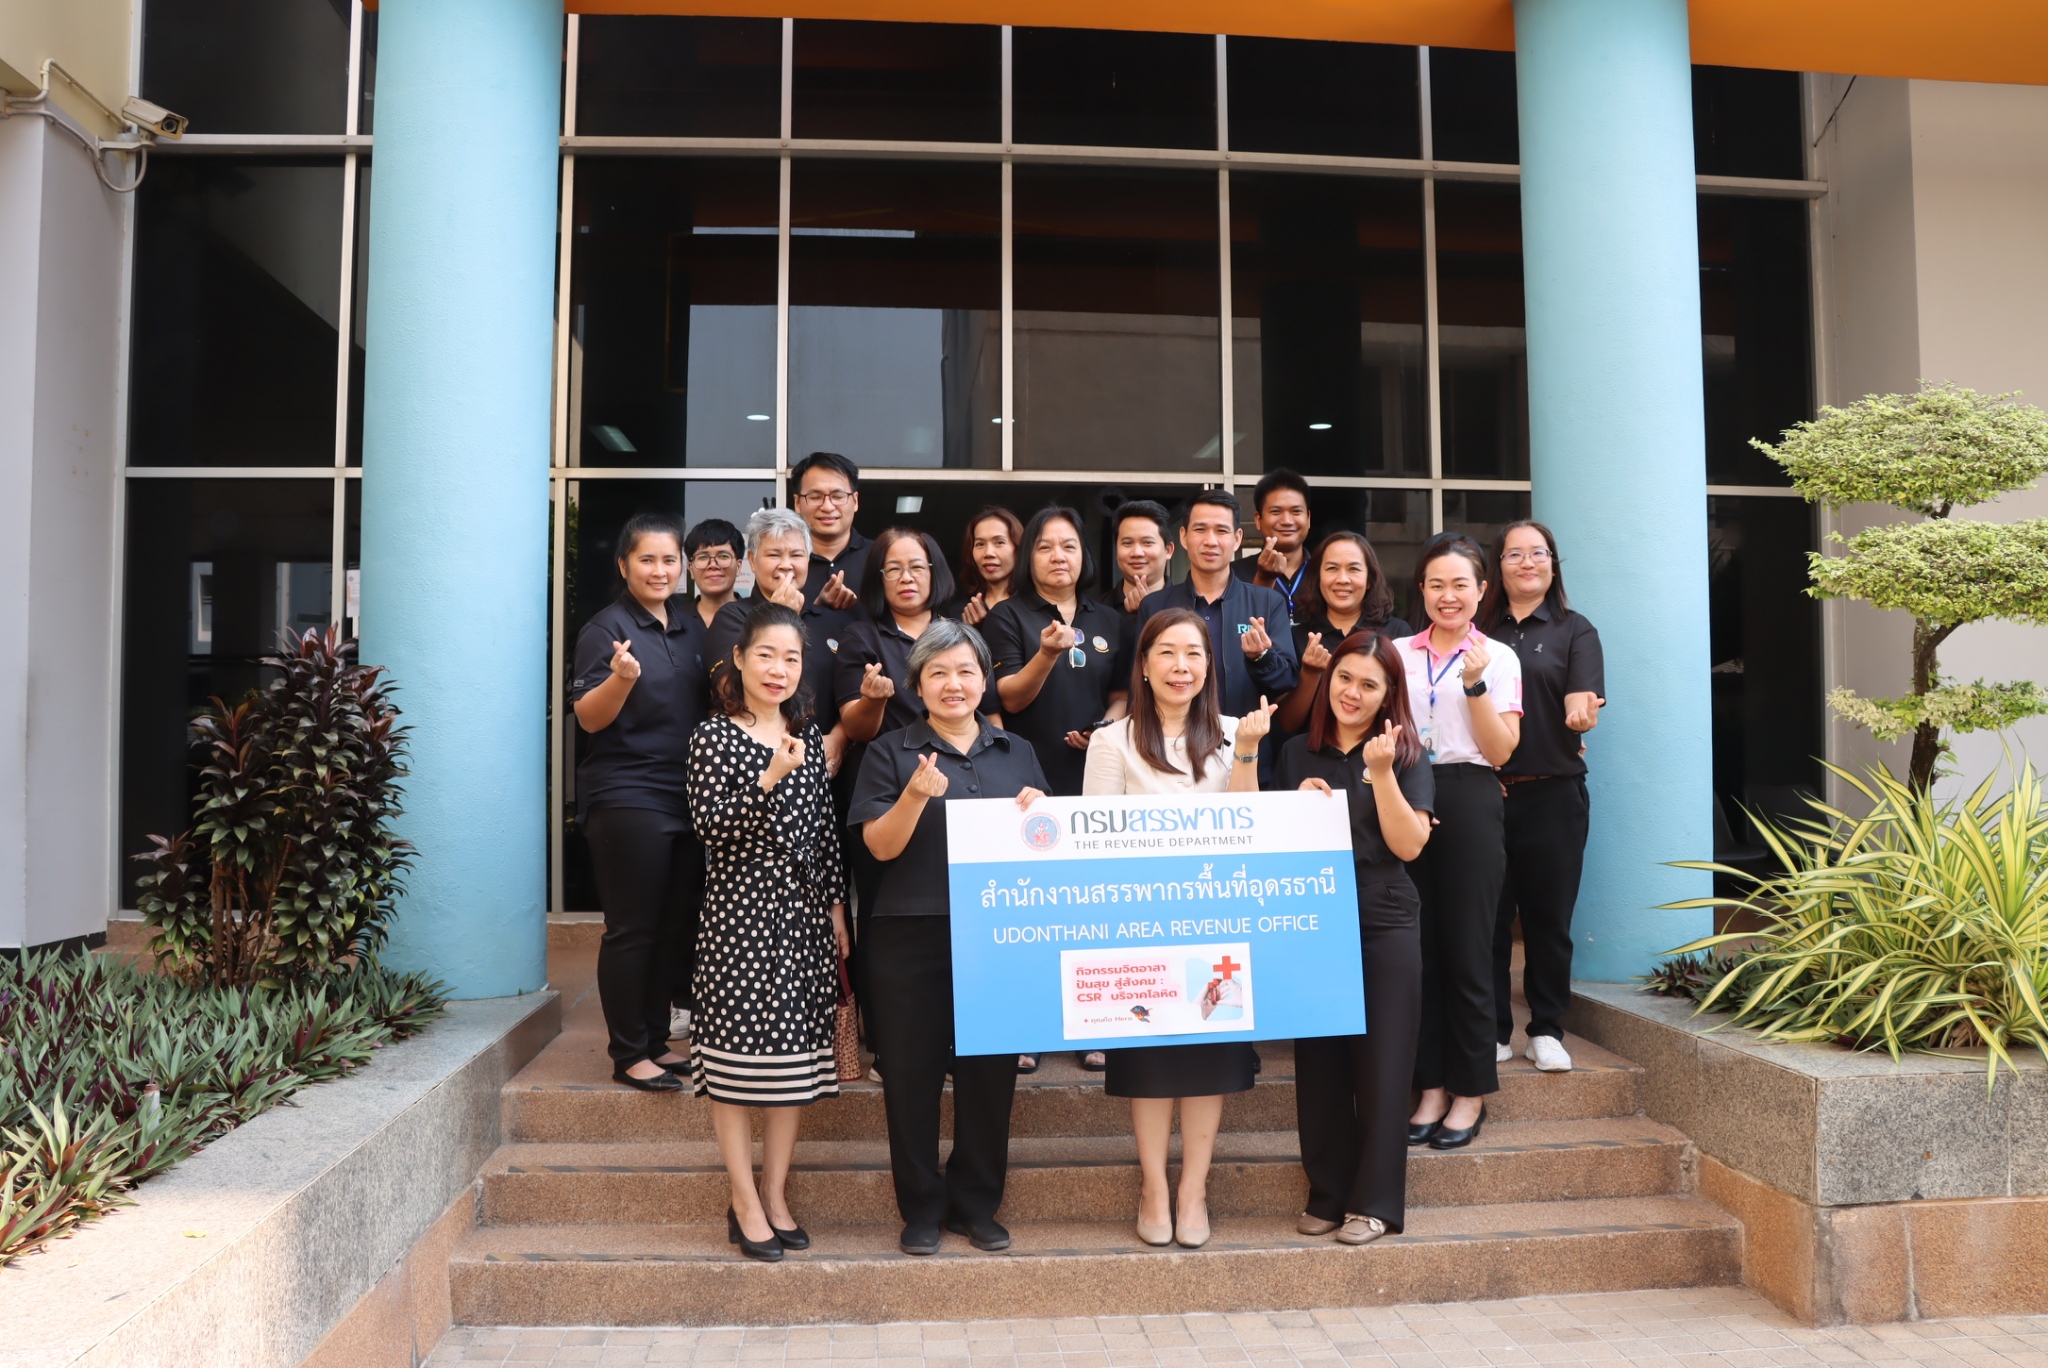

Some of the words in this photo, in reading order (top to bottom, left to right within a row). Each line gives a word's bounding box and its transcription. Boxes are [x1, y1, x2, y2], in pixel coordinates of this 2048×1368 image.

[1070, 806, 1254, 834] กรมสรรพากร
[1074, 840, 1099, 850] THE
[1105, 838, 1164, 849] REVENUE
[1169, 835, 1254, 847] DEPARTMENT
[980, 863, 1336, 908] สำนักงานสรรพากรพื้นที่อุดรธานี
[993, 923, 1109, 944] UDONTHANI
[1116, 921, 1165, 939] AREA
[1171, 917, 1252, 937] REVENUE
[1258, 914, 1319, 933] OFFICE
[1076, 964, 1166, 976] กิจกรรมจิตอาสา
[1077, 992, 1102, 1002] CSR
[1111, 989, 1178, 1001] บริจาคโลหิต
